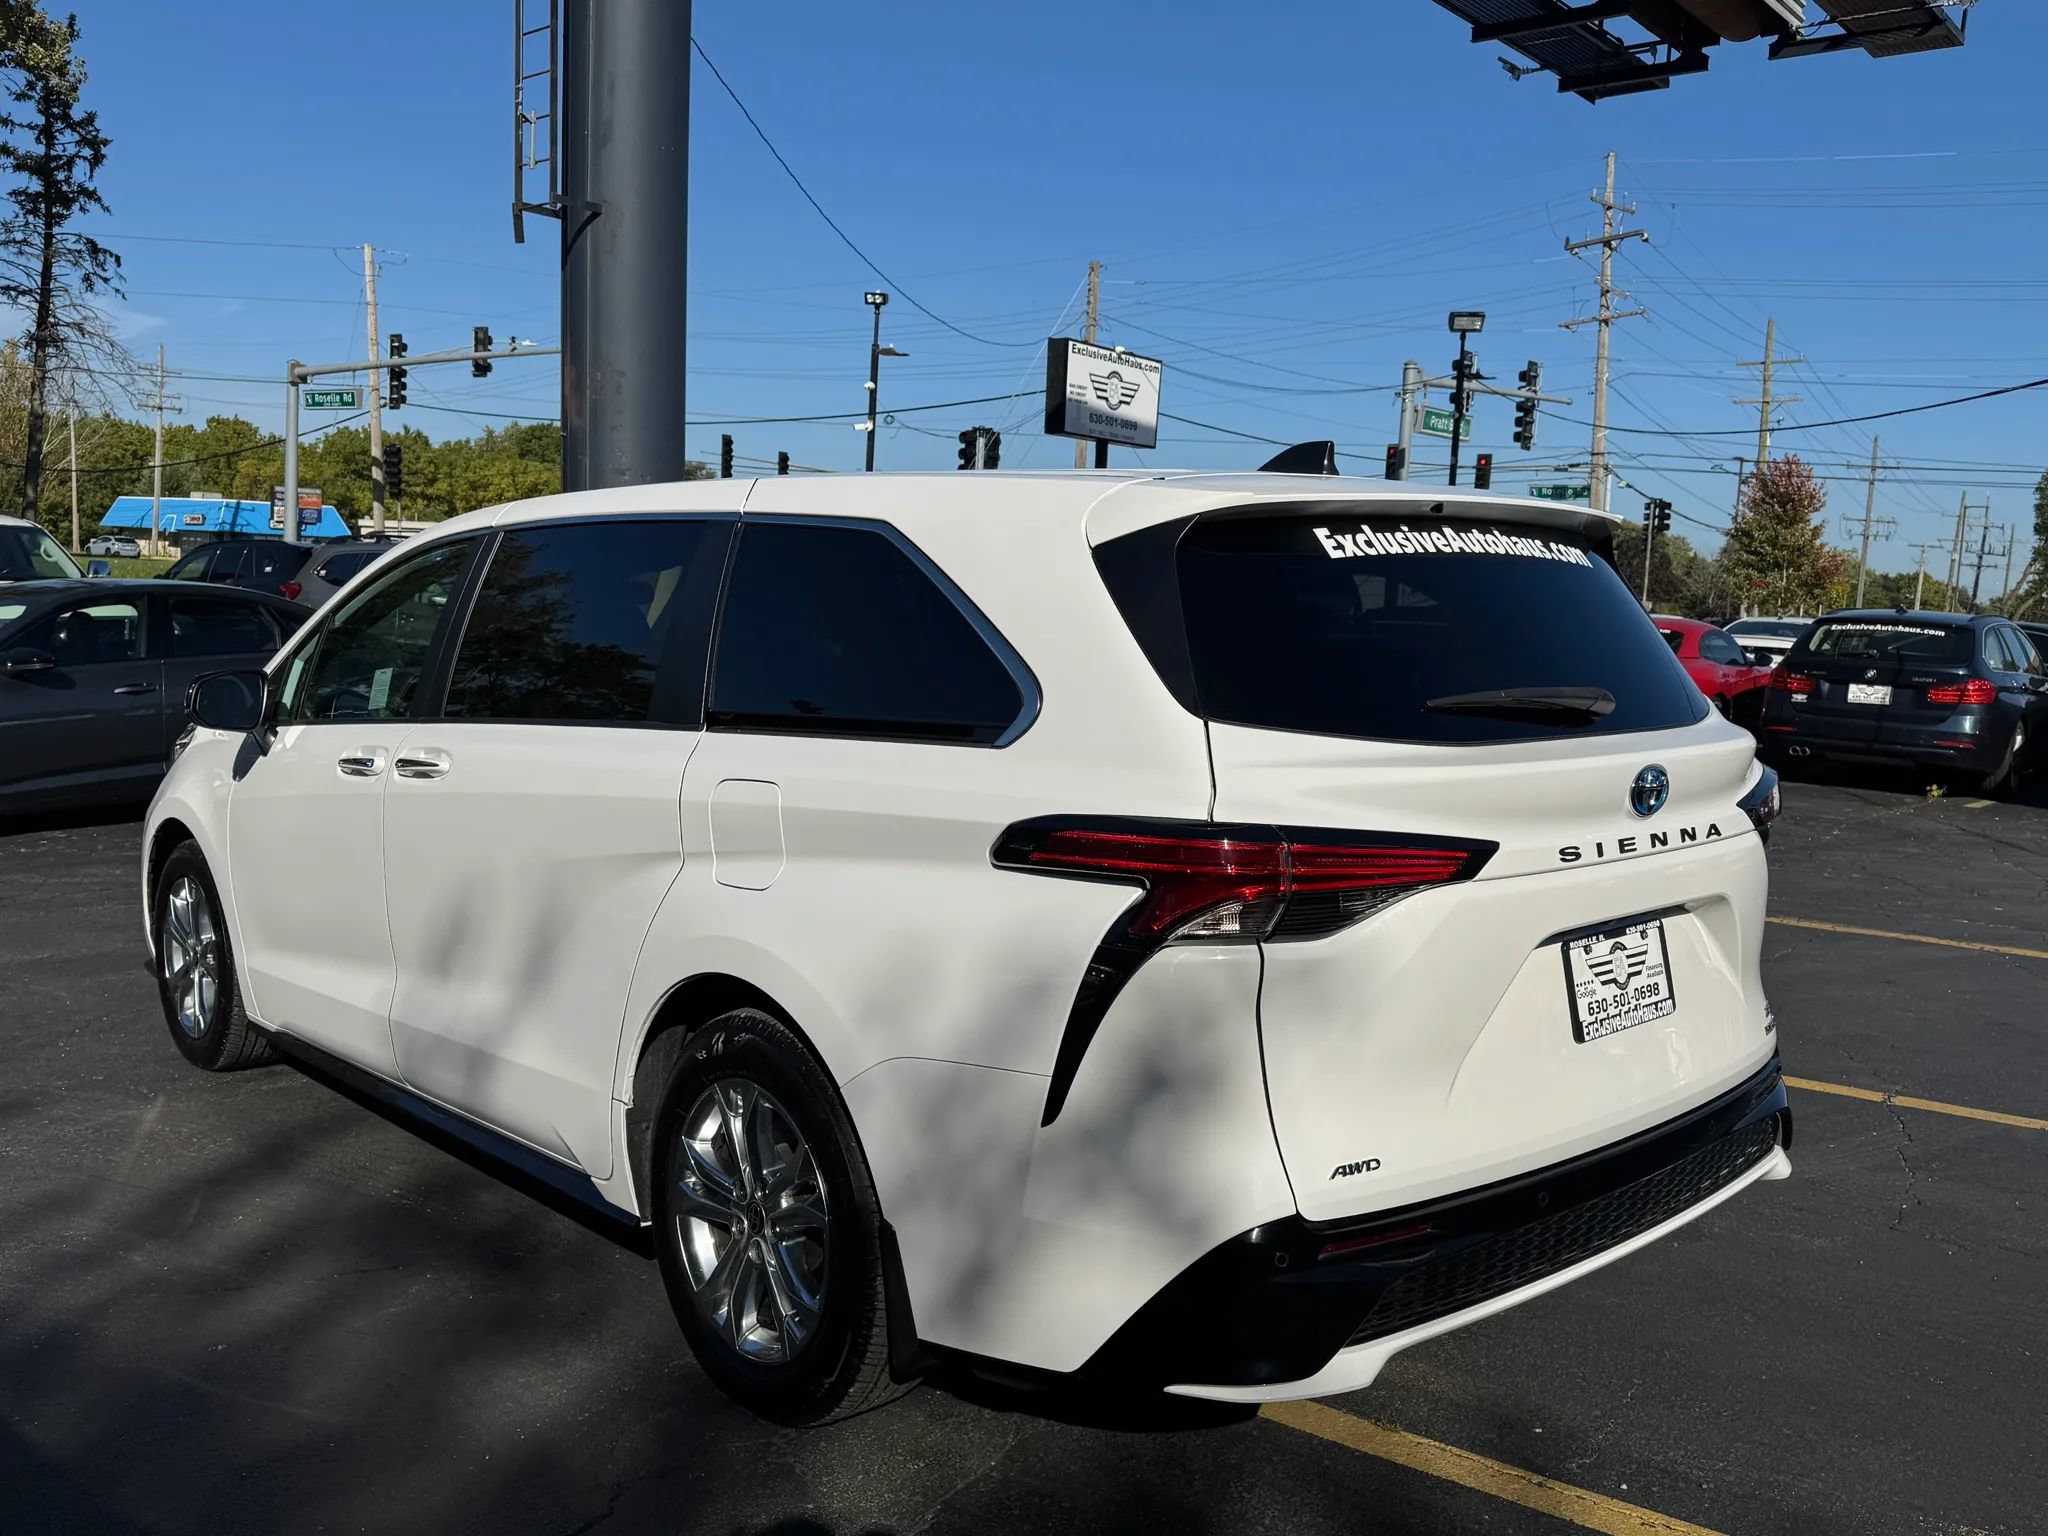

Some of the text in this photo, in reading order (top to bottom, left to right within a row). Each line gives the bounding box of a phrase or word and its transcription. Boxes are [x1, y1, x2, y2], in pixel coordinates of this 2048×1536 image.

[314, 393, 353, 403] Roselle Rd
[1089, 412, 1138, 431] 630-501-0698
[1430, 415, 1448, 430] Pratt
[1312, 524, 1594, 568] ExclusiveAutohaus.com
[1831, 623, 1946, 637] ExclusiveAutohaus.com
[1558, 823, 1723, 863] SIENNA
[1569, 935, 1599, 949] ROSELLE
[1576, 987, 1598, 999] Google
[1587, 982, 1660, 1016] 630-501-0698
[1581, 998, 1674, 1041] ExclusiveAutoHaus.com
[1328, 1158, 1381, 1181] AWD
